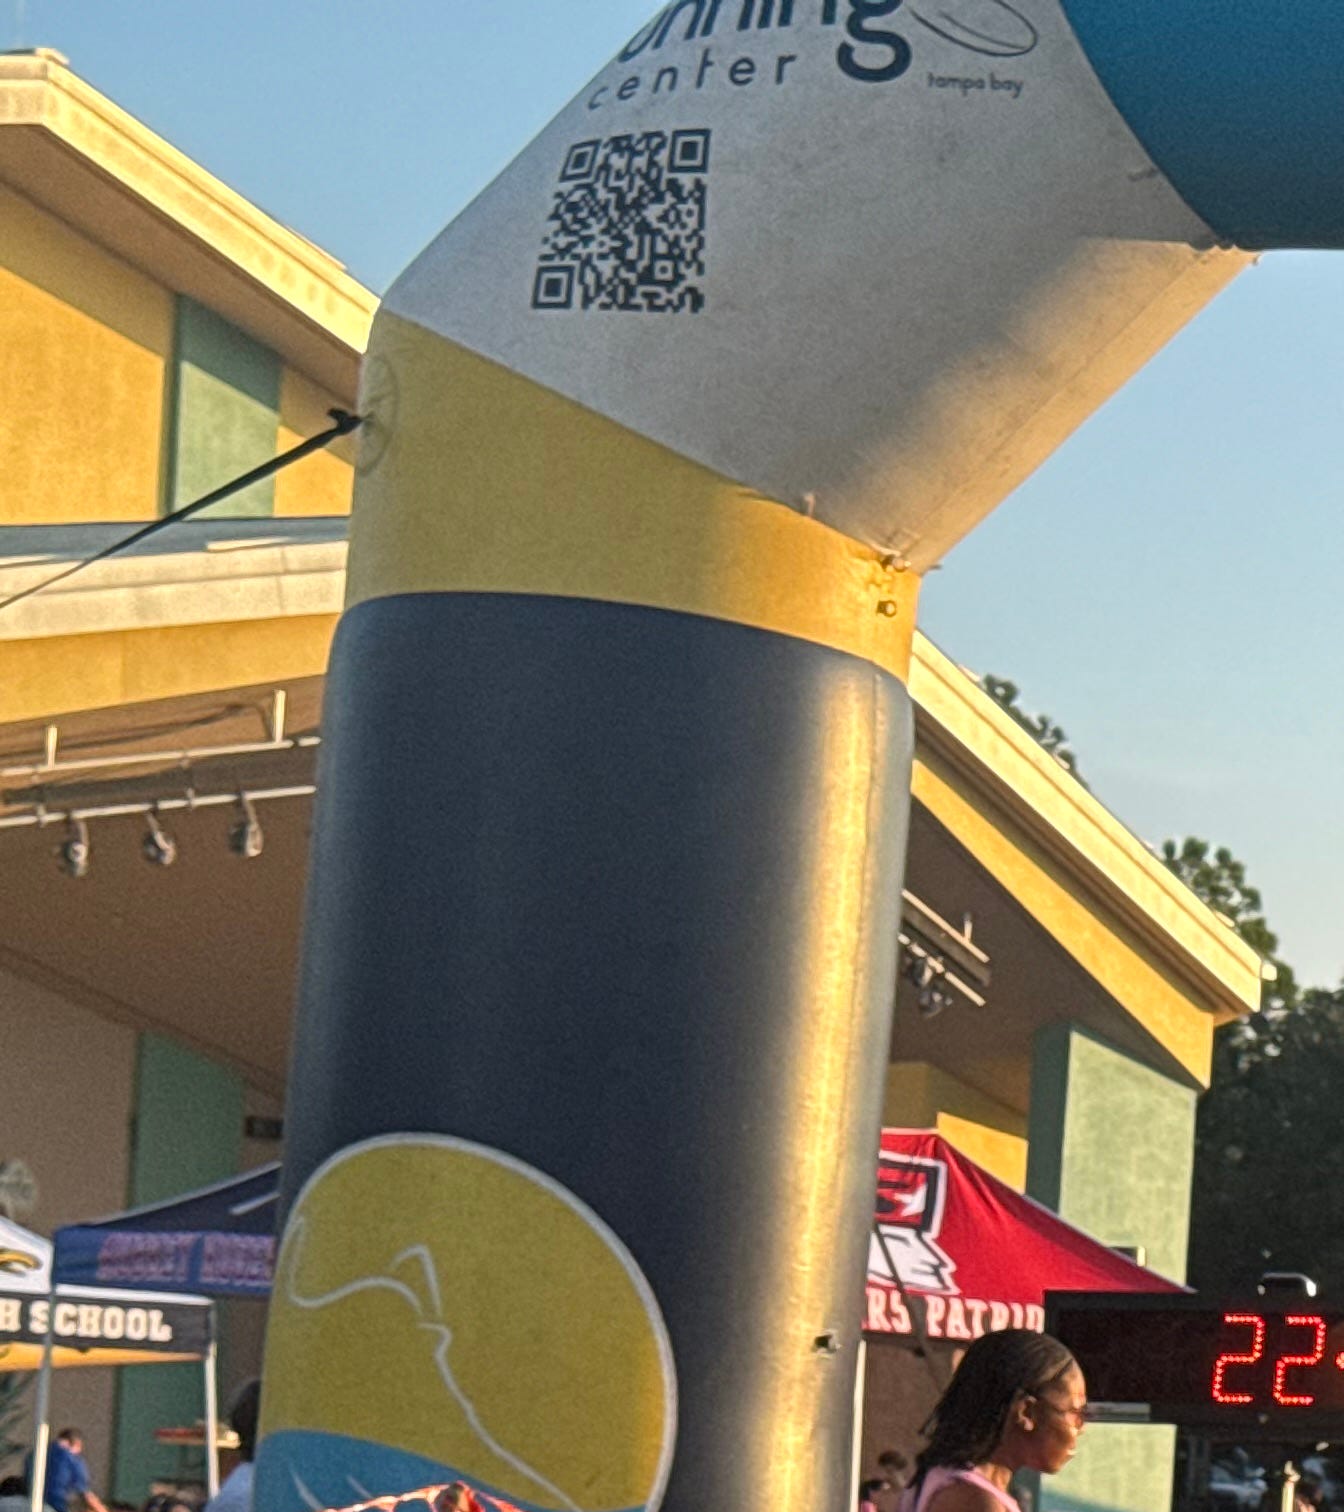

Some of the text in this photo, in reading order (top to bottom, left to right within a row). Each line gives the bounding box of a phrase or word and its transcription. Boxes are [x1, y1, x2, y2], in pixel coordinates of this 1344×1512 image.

[588, 50, 797, 110] center
[927, 72, 1023, 99] tampa bay
[28, 1300, 173, 1342] SCHOOL
[862, 1287, 912, 1334] RS
